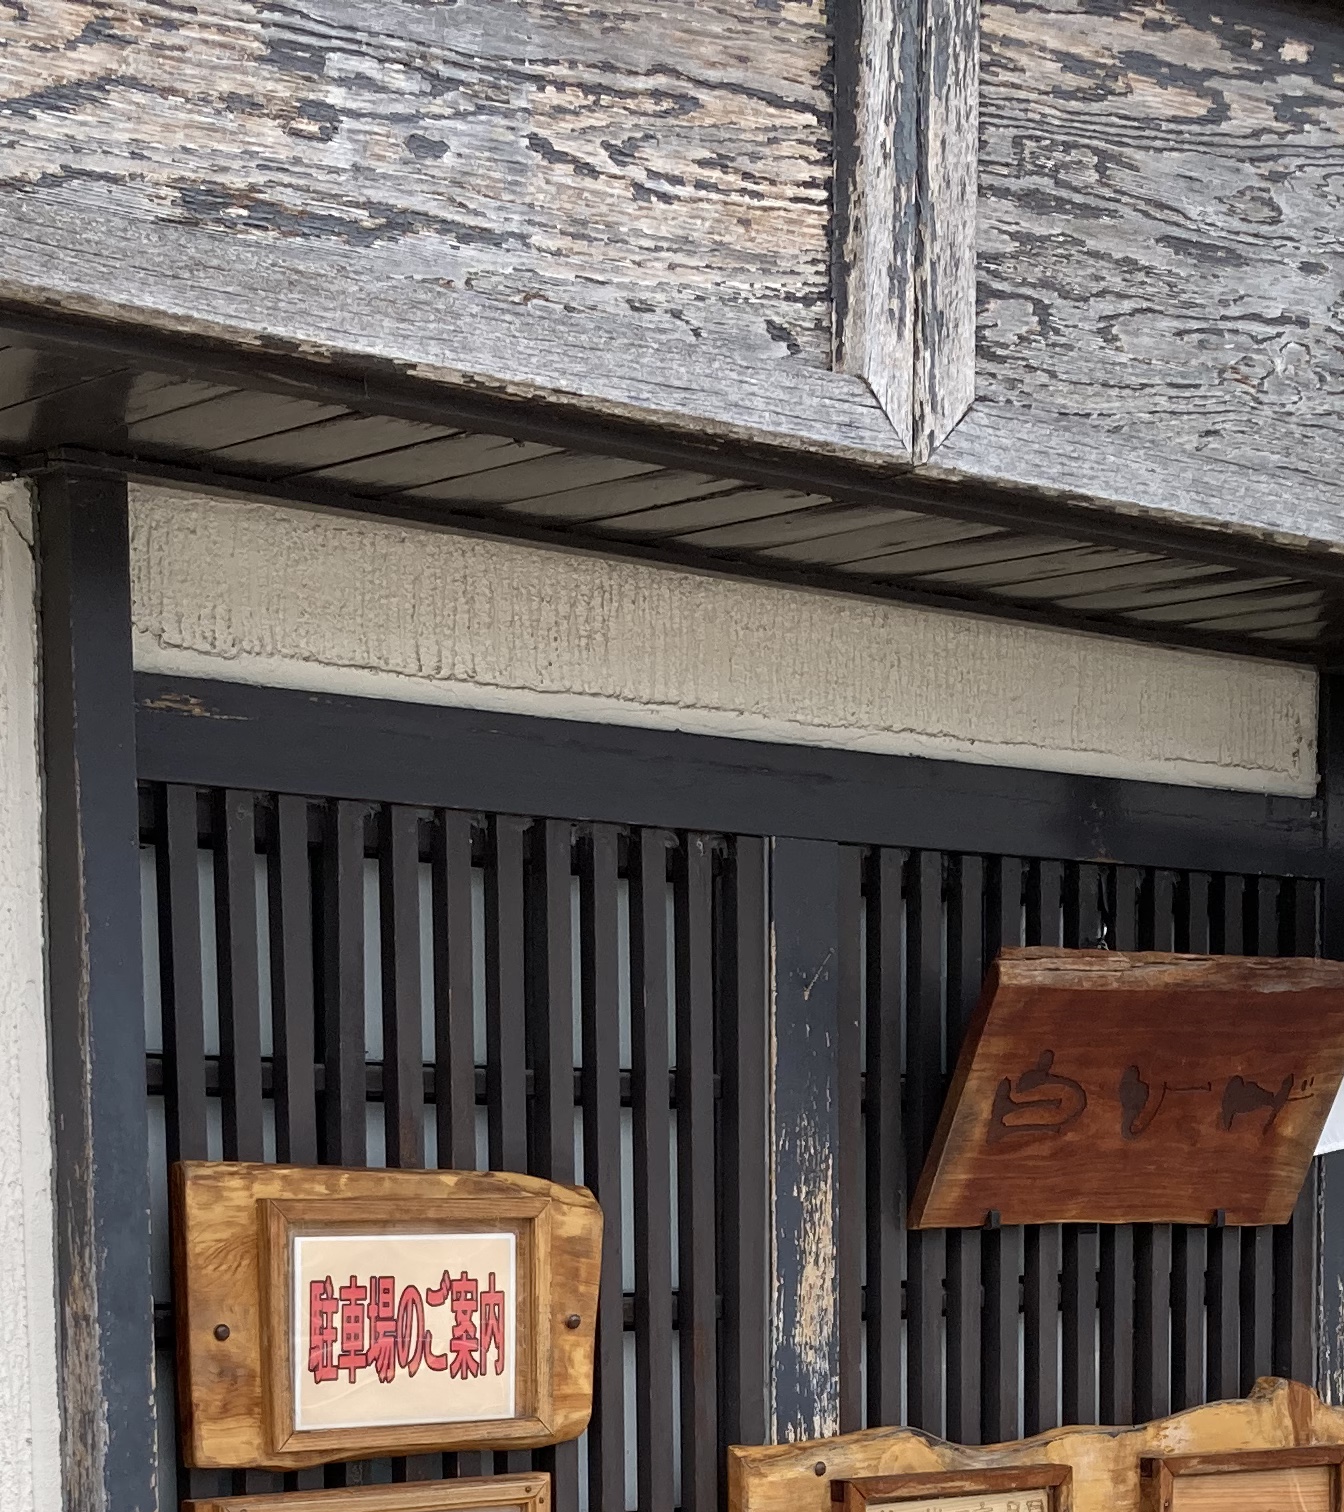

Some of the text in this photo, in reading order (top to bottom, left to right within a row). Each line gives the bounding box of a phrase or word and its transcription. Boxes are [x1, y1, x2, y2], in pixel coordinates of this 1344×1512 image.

[308, 1270, 505, 1384] 駐車場のご案内
